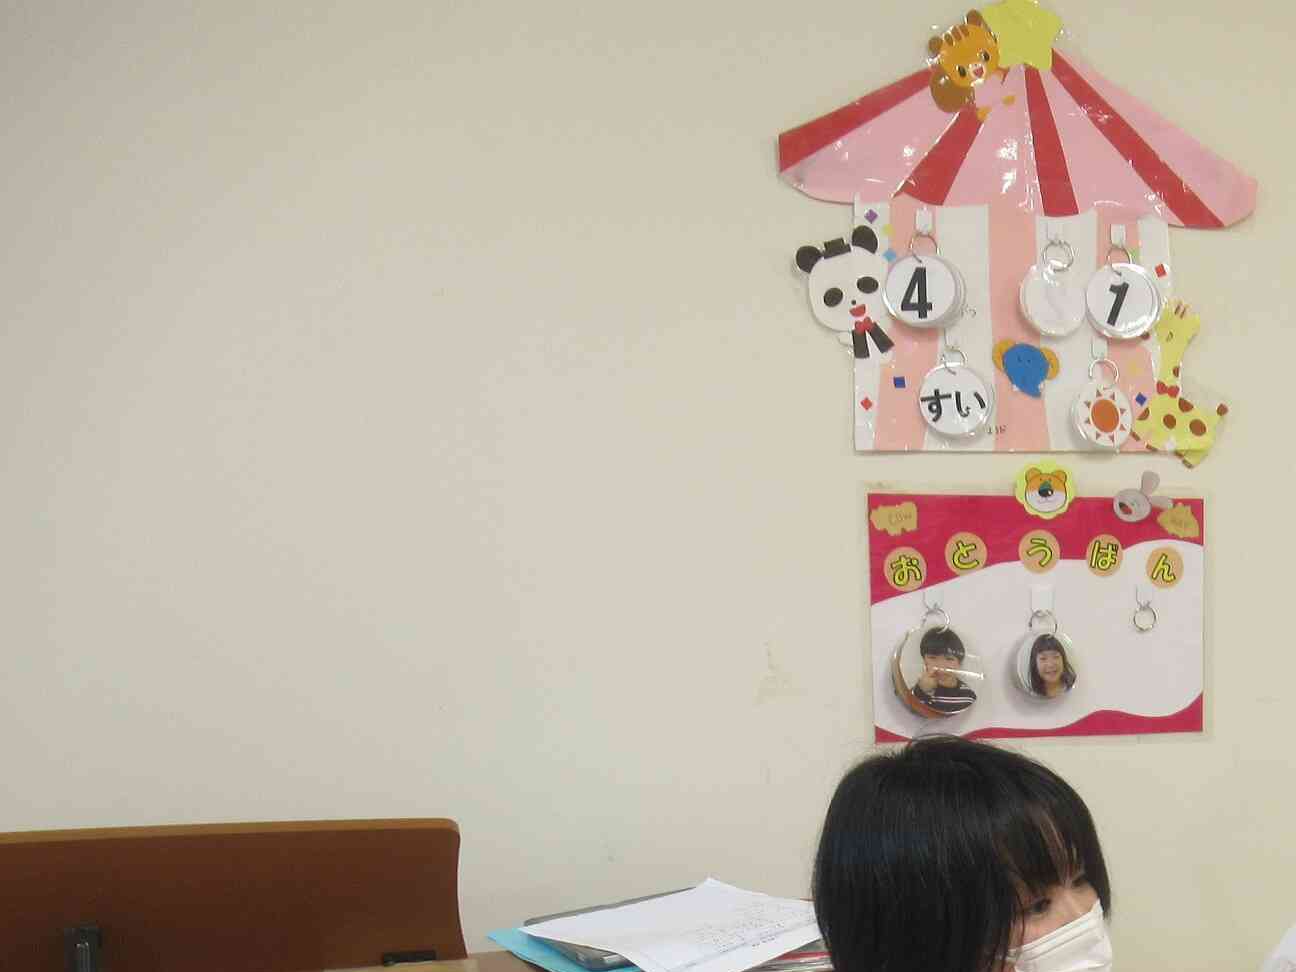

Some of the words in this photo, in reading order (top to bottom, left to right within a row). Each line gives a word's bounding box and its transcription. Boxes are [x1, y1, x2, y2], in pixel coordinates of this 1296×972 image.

[901, 267, 932, 319] 4
[919, 388, 986, 422] すい
[890, 536, 1176, 587] おとうばん
